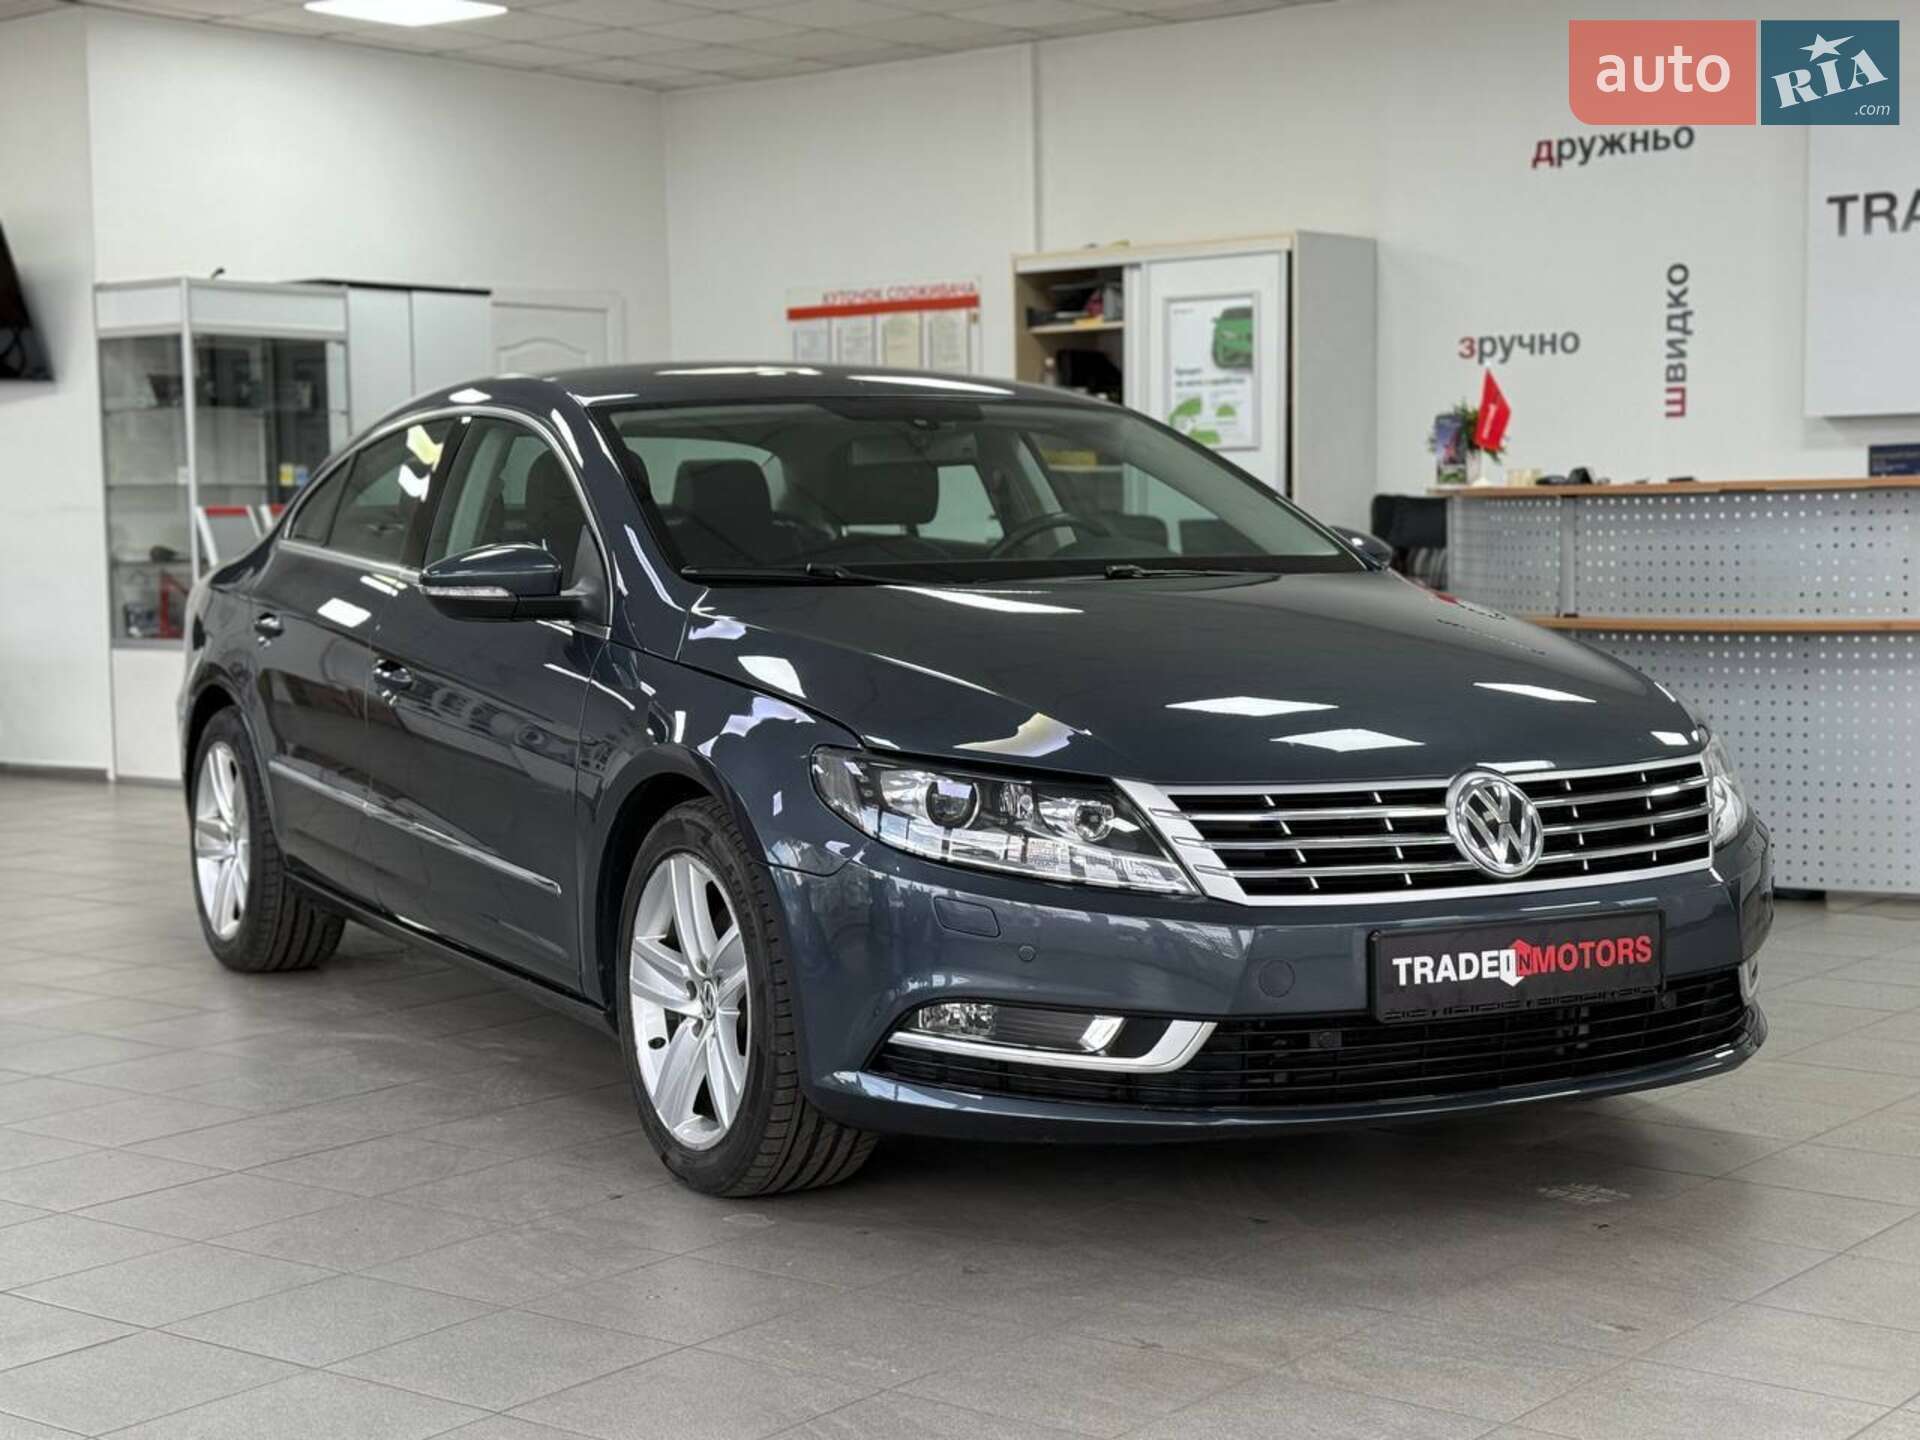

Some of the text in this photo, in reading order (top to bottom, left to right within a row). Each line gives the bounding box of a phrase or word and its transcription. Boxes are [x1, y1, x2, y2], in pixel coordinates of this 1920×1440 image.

[1532, 126, 1695, 168] дружньо
[1458, 331, 1581, 365] зручно
[1665, 263, 1693, 418] швидко
